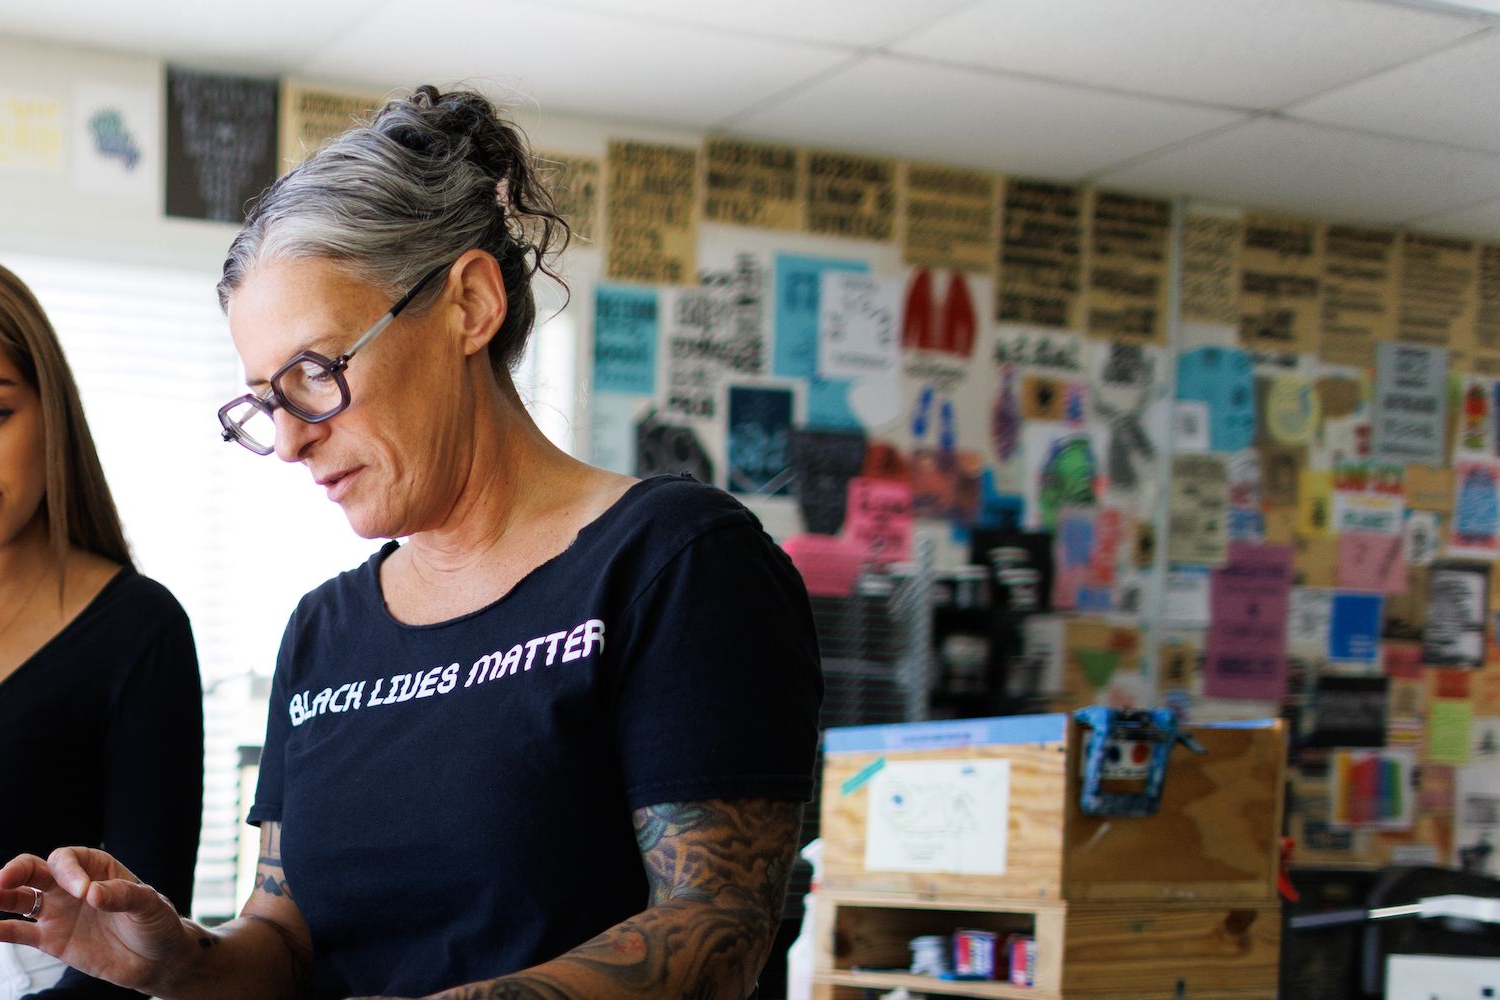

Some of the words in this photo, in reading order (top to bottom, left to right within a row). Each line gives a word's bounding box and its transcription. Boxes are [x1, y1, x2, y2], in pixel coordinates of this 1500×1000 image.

[289, 680, 367, 727] BLACK
[367, 662, 460, 708] LIVES
[464, 618, 606, 688] MATTER
